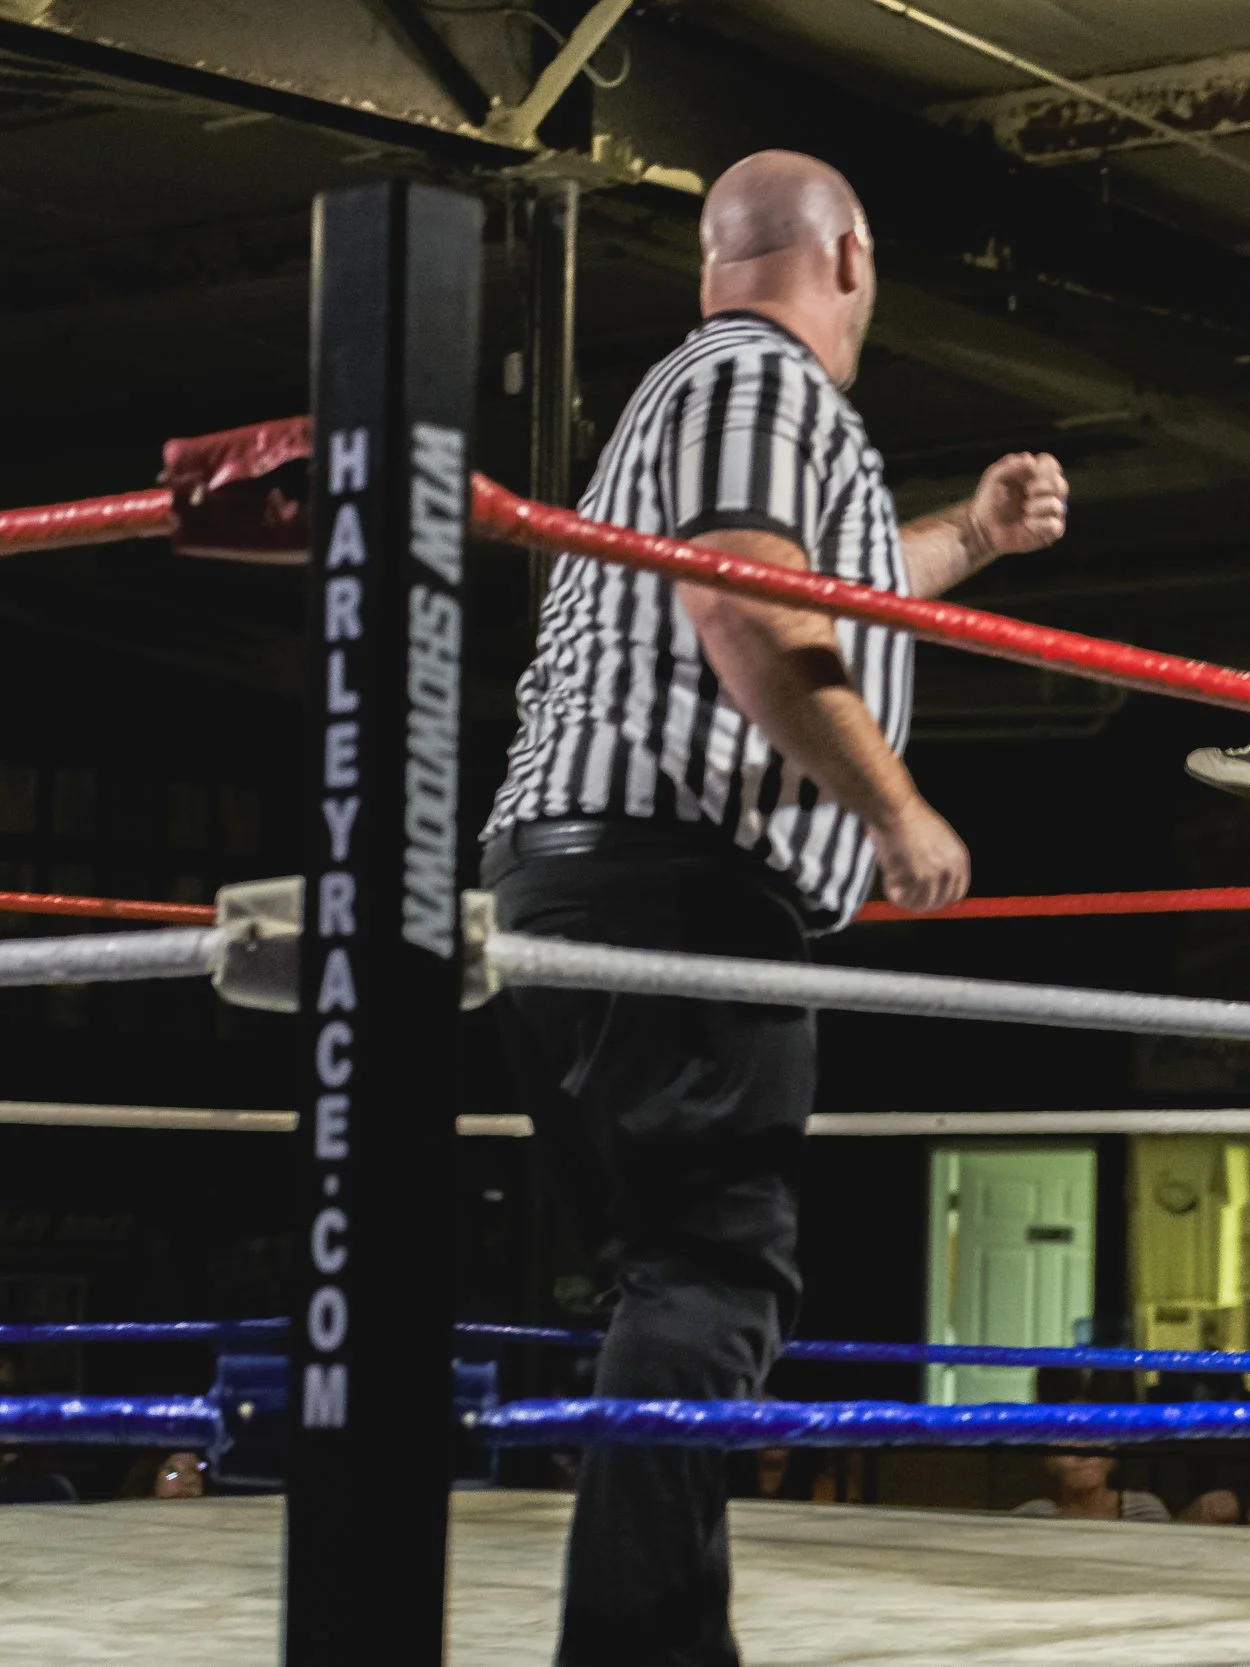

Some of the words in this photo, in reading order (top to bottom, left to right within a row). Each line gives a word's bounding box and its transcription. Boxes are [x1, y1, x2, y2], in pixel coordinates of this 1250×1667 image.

[410, 423, 466, 584] WLW
[304, 429, 367, 1429] HARLEYRACE.COM
[402, 588, 462, 959] SHOWDOWN
